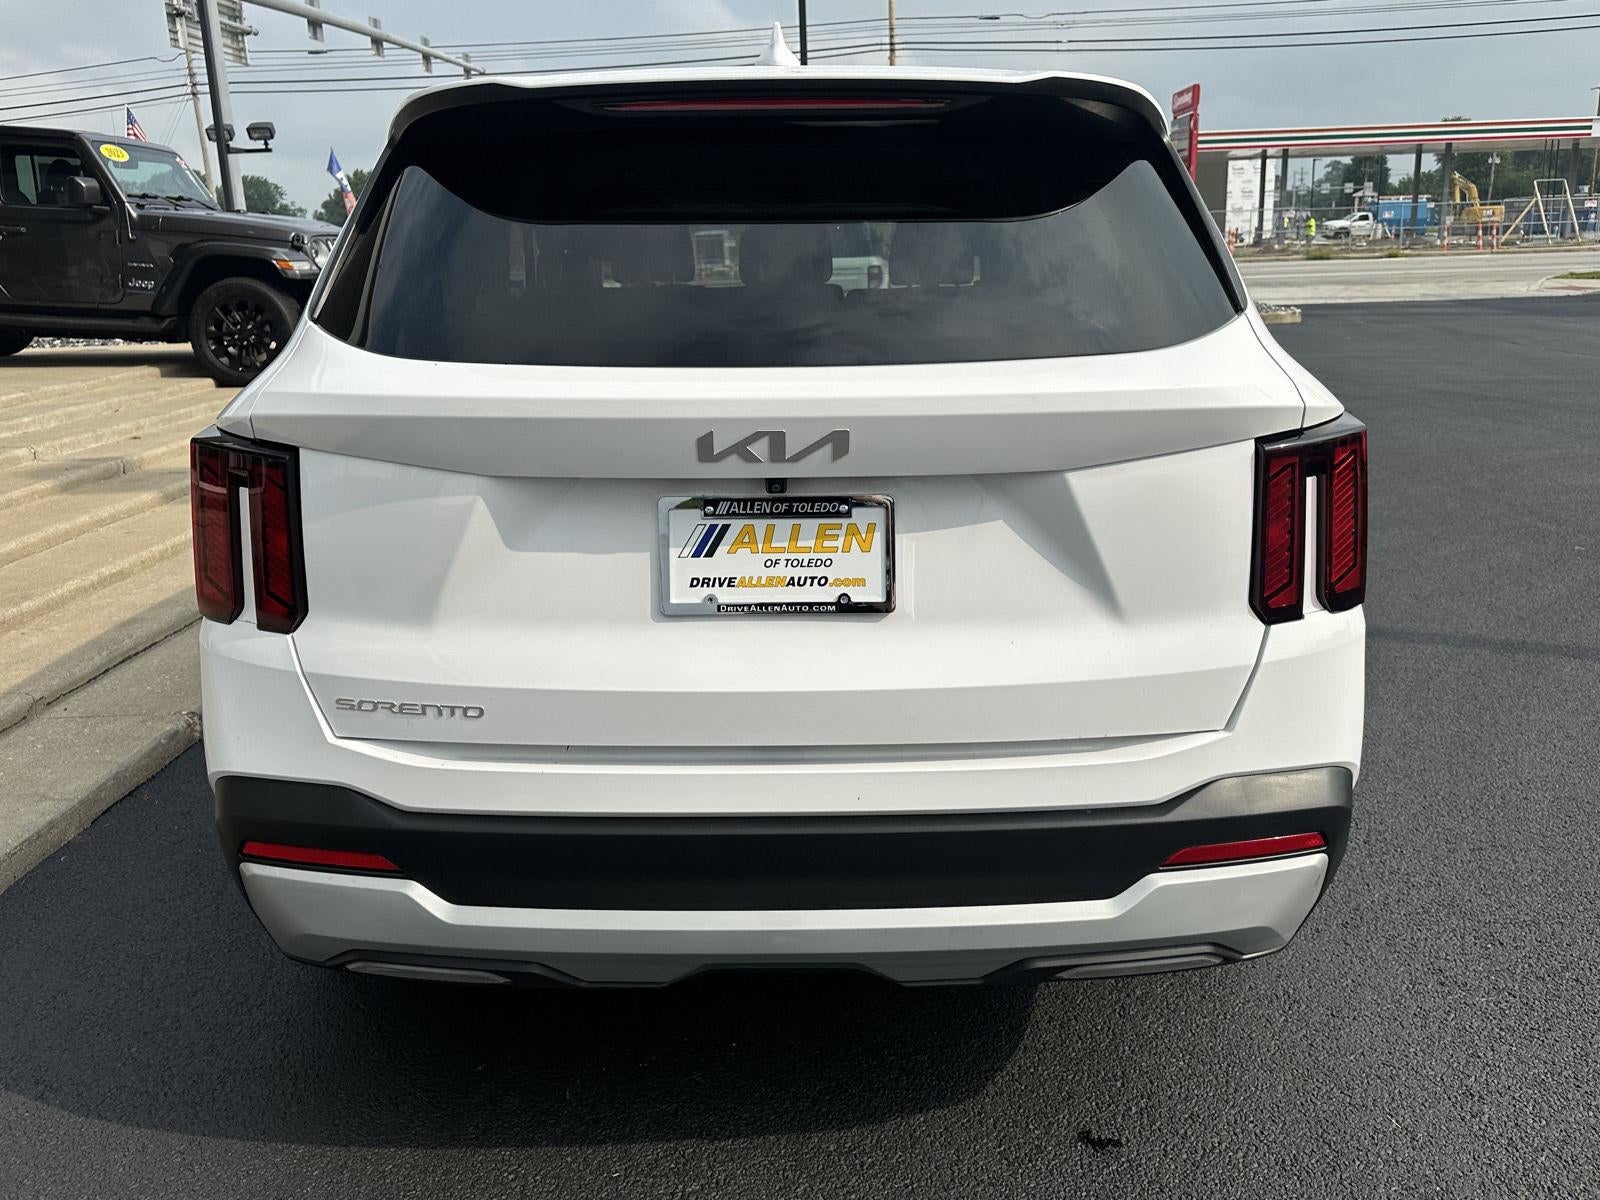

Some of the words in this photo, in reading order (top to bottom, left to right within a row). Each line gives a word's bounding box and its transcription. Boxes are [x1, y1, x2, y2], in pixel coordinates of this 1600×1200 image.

[128, 277, 155, 290] Jeep
[697, 429, 850, 463] KIA
[729, 501, 771, 514] ALLEN
[772, 502, 789, 513] OF
[791, 502, 840, 513] TOLEDO
[727, 522, 877, 554] ALLEN
[763, 558, 782, 568] OF
[783, 558, 833, 568] TOLEDO
[689, 575, 866, 588] DRIVEALLENAUTO.com
[335, 697, 485, 719] SORENTO
